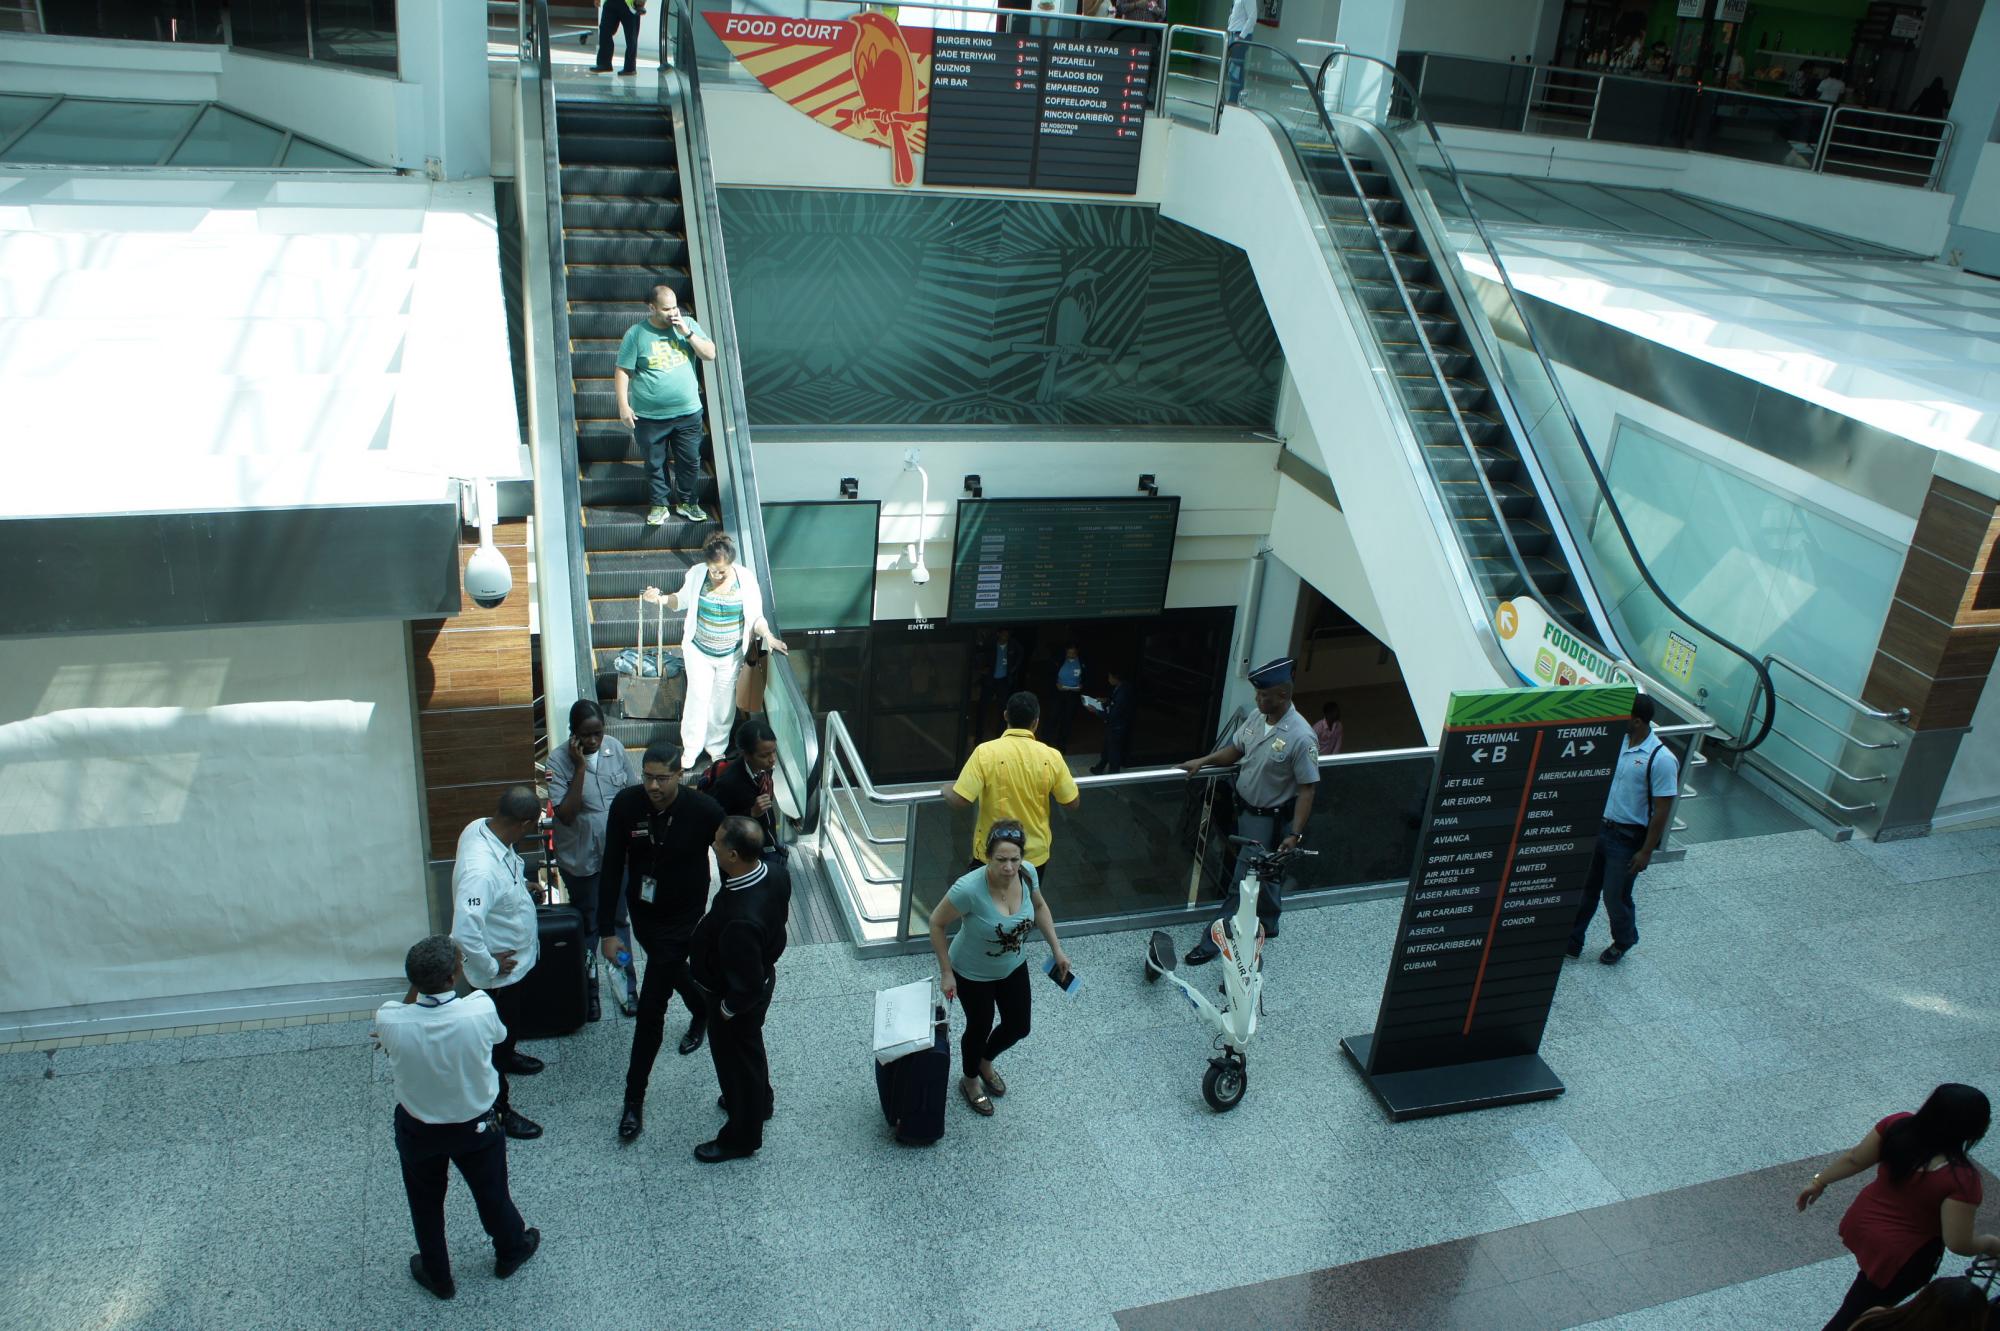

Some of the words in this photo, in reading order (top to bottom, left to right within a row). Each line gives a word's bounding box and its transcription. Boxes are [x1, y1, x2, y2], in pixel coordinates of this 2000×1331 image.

[726, 19, 776, 36] FOOD
[781, 22, 842, 40] COURT
[936, 36, 970, 45] BURGER
[972, 38, 992, 46] KING
[1053, 42, 1066, 50] AIR
[1068, 44, 1084, 52] BAR
[1094, 46, 1118, 55] TAPAS
[936, 50, 958, 58] JADE
[960, 51, 996, 60] TERIYAKI
[1052, 56, 1095, 67] PIZZARELLI
[935, 64, 971, 73] QUIZNOS
[1048, 70, 1084, 79] HELADOS
[1086, 73, 1103, 81] BON
[950, 78, 968, 87] BAR
[1046, 83, 1099, 94] EMPAREDADO
[1045, 97, 1107, 108] COFFEELOPOLIS
[1044, 110, 1073, 119] RINCON
[1075, 112, 1114, 122] CARIBEÑO
[1543, 622, 1627, 684] FOODCOUT
[1557, 726, 1608, 739] TERMINAL
[1465, 732, 1520, 745] TERMINAL
[1492, 746, 1507, 763] B
[1561, 742, 1576, 758] A
[1538, 770, 1577, 780] AMERICAN
[1578, 768, 1610, 778] AIRLINES
[1445, 779, 1460, 788] JET
[1462, 778, 1484, 786] BLUE
[1533, 790, 1558, 800] DELTA
[1441, 798, 1457, 806] AIR
[1458, 796, 1491, 805] EUROPA
[1528, 810, 1554, 818] IBERIA
[1434, 817, 1458, 826] PAWA
[1524, 827, 1538, 836] AIR
[1539, 825, 1572, 835] FRANCE
[1433, 834, 1470, 844] AVIANCA
[1518, 843, 1574, 856] AEROMEXICO
[1428, 855, 1455, 864] SPIRIT
[1456, 851, 1493, 861] AIRLINES
[1439, 868, 1474, 876] ANTILLES
[1516, 863, 1546, 873] UNITED
[1424, 876, 1458, 886] EXPRESS
[1532, 877, 1556, 885] AEREAS
[1415, 890, 1443, 900] LASER
[1444, 887, 1480, 897] AIRLINES
[1519, 884, 1554, 892] VENEZUELA
[468, 898, 480, 906] 113
[1504, 900, 1526, 909] COPA
[1528, 896, 1561, 906] AIRLINES
[1416, 910, 1431, 919] AIR
[1433, 905, 1473, 917] CARAIBES
[1502, 917, 1535, 926] CONDOR
[1409, 926, 1444, 936] ASERCA
[1407, 939, 1482, 954] INTERCARIBBEAN
[1403, 960, 1437, 971] CUBANA
